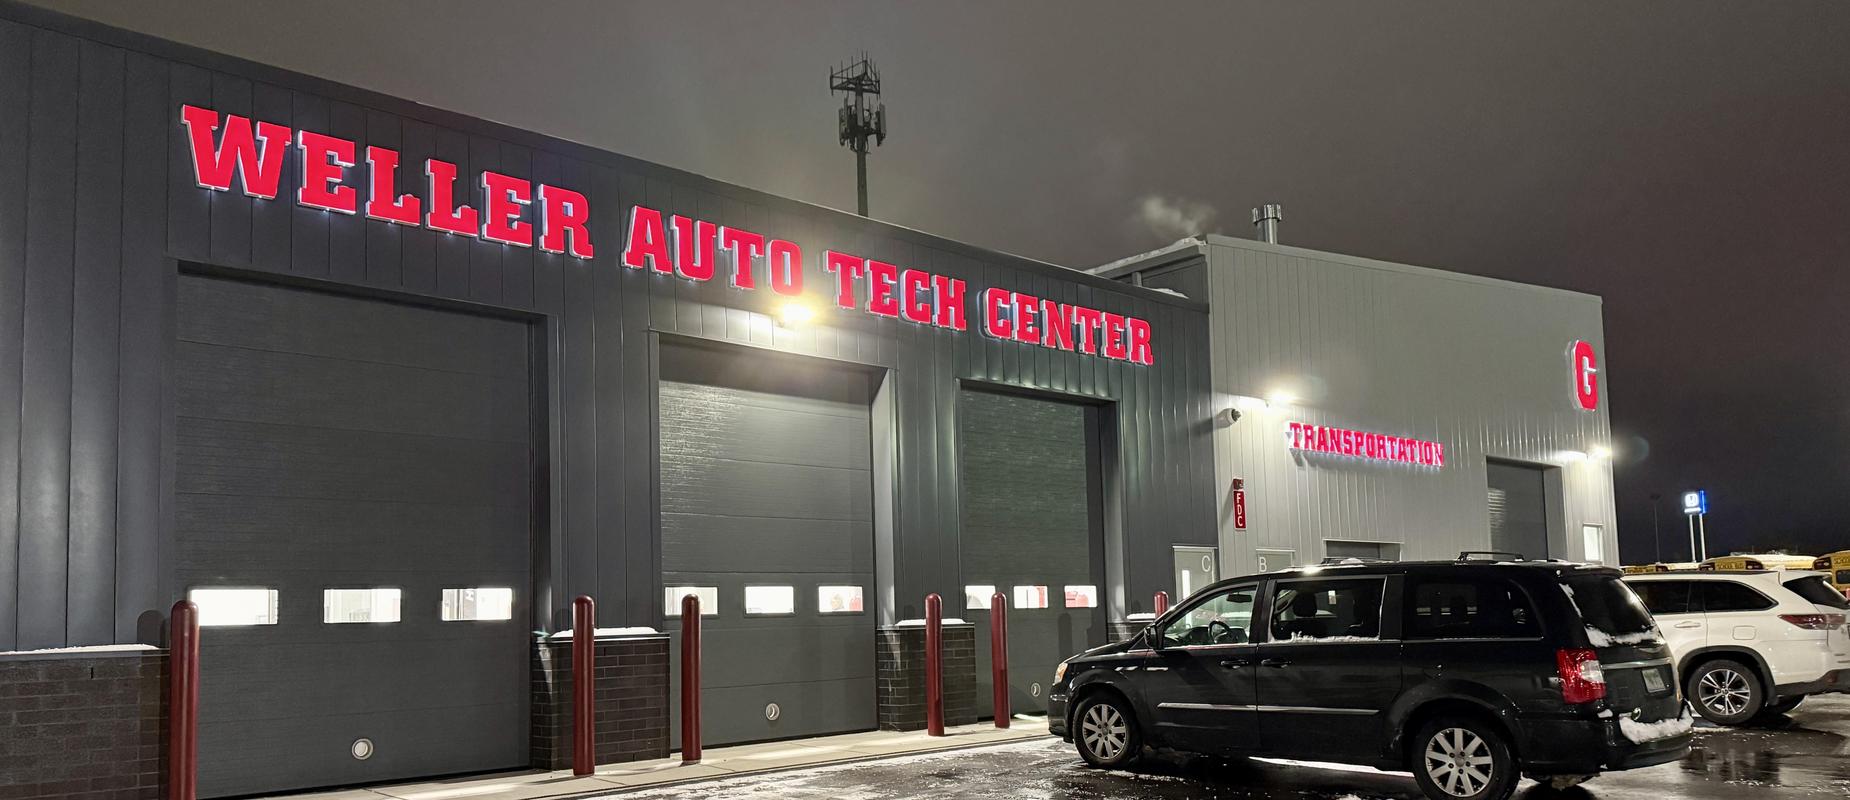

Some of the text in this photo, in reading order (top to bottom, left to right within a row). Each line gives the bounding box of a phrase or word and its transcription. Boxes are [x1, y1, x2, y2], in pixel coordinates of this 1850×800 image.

[181, 104, 1155, 366] WELLER AUTO TECH CENTER
[1573, 340, 1599, 411] G
[1288, 422, 1446, 467] TRANSPORTATION
[1236, 492, 1244, 527] FDC
[1201, 555, 1211, 572] C
[1259, 556, 1267, 572] B
